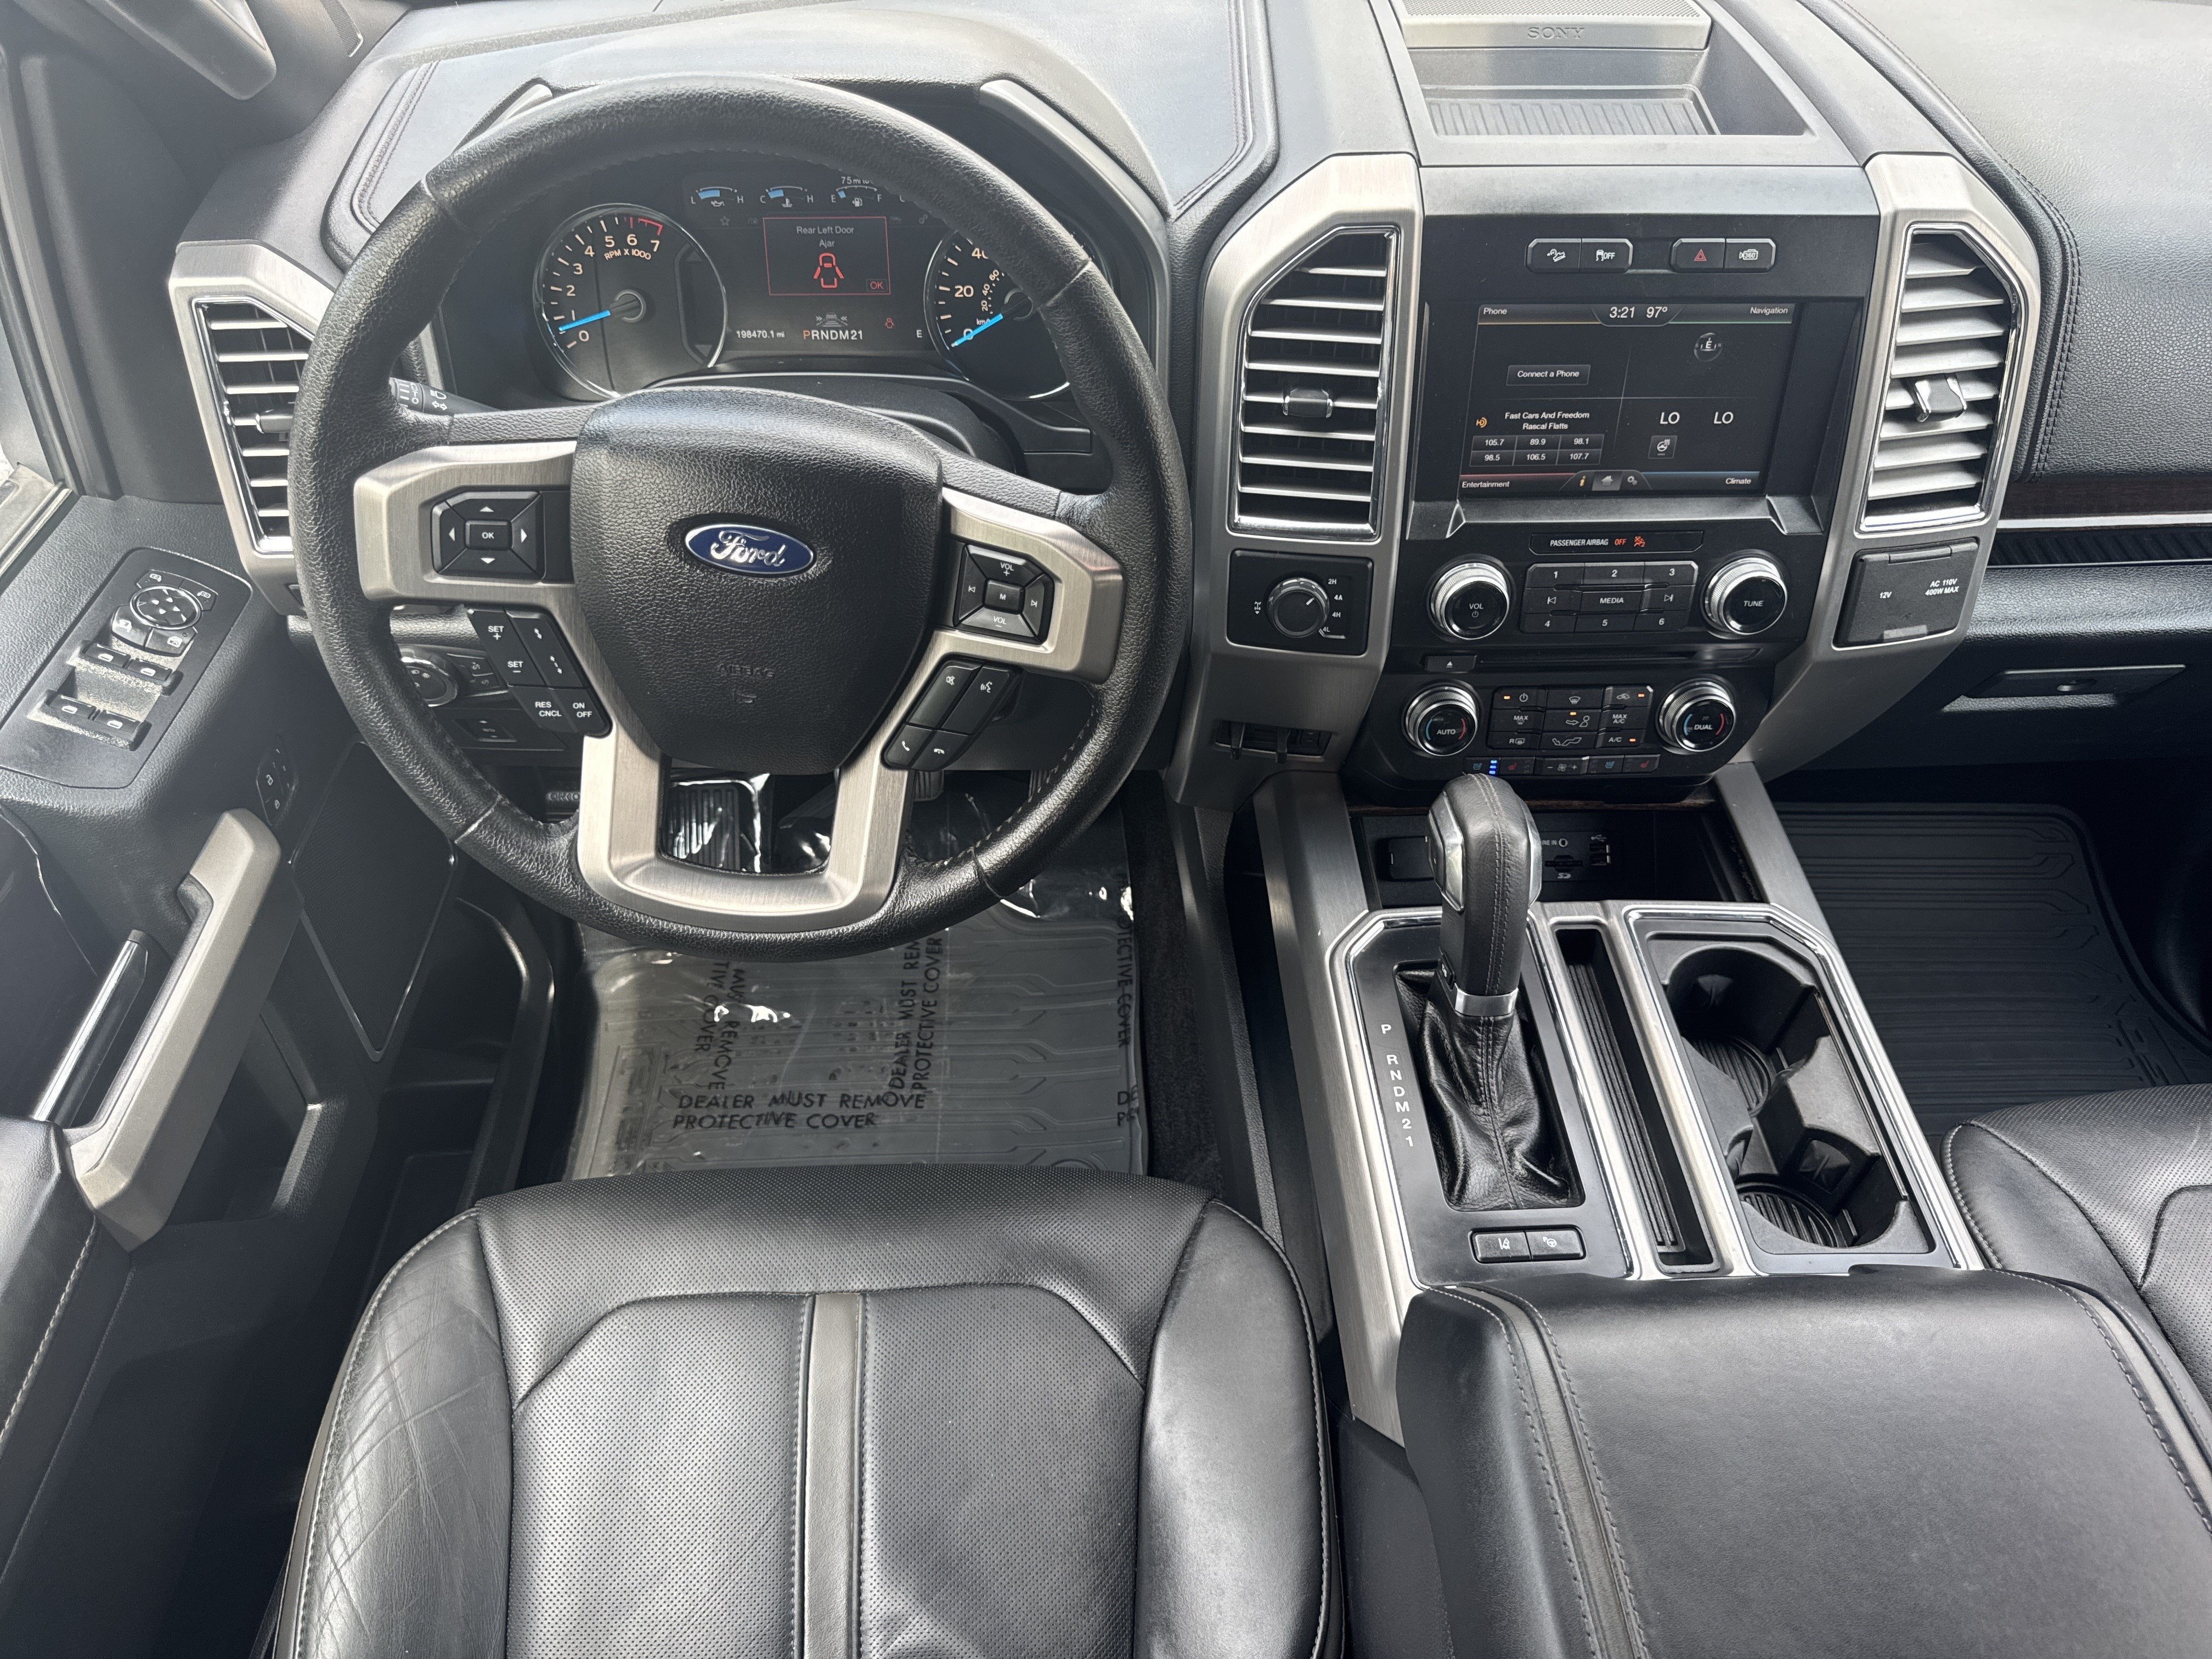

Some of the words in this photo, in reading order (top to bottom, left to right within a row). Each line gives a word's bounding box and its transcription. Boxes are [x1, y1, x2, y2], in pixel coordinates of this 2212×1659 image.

[1528, 27, 1584, 40] SONY
[841, 176, 852, 184] 75
[691, 196, 696, 205] L
[737, 195, 744, 204] H
[760, 195, 766, 204] C
[806, 195, 814, 203] H
[831, 194, 836, 203] E
[877, 194, 882, 203] F
[796, 226, 815, 235] Rear
[817, 225, 833, 235] Left
[835, 225, 855, 234] Door
[605, 236, 616, 247] 5
[627, 234, 637, 246] 6
[819, 239, 835, 249] Ajar
[584, 246, 595, 257] 4
[650, 240, 660, 252] 7
[604, 250, 621, 261] RPM
[631, 249, 652, 260] 1000
[573, 263, 583, 275] 3
[989, 269, 1000, 281] 60
[566, 285, 576, 296] 2
[870, 281, 884, 290] OK
[954, 285, 974, 297] 20
[982, 284, 990, 296] 40
[981, 300, 988, 312] 20
[1750, 307, 1788, 315] Navigation
[1609, 307, 1635, 318] 3:21
[578, 330, 590, 342] 0
[736, 331, 775, 339] 198470.1
[916, 330, 923, 338] E
[1660, 412, 1680, 424] LO
[1713, 411, 1734, 424] LO
[710, 529, 787, 567] Ford
[1000, 562, 1014, 571] VOL
[993, 616, 1007, 625] VOL
[899, 980, 917, 1020] MUST
[911, 999, 937, 1092] PROTECTIVE
[924, 938, 943, 993] COVER
[1381, 1024, 1392, 1034] P
[889, 1032, 911, 1090] DEALER
[1386, 1054, 1398, 1065] R
[1390, 1070, 1402, 1081] N
[1393, 1086, 1405, 1097] D
[678, 1094, 755, 1110] DEALER
[769, 1091, 827, 1107] MUST
[840, 1092, 924, 1109] REMOVE
[1395, 1101, 1410, 1113] M
[672, 1111, 796, 1129] PROTECTIVE
[806, 1113, 877, 1128] COVER
[1402, 1118, 1412, 1129] 2
[1405, 1136, 1414, 1147] 1
